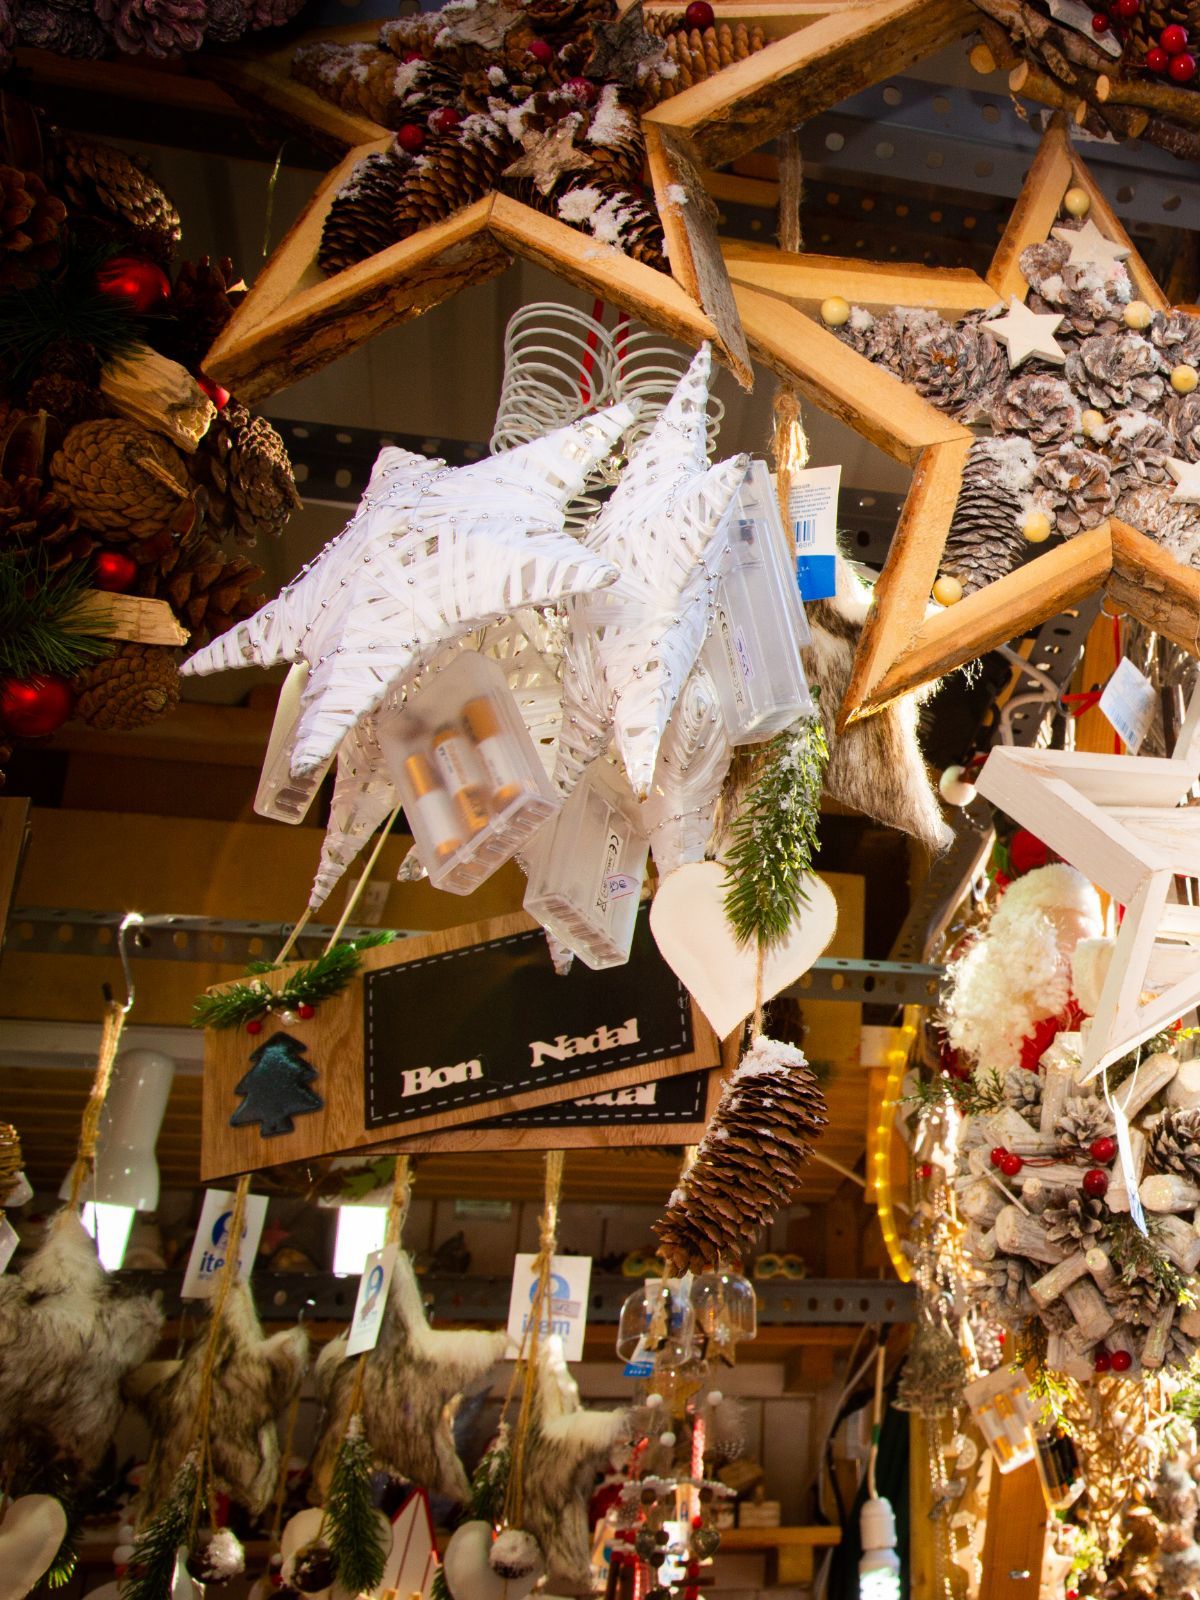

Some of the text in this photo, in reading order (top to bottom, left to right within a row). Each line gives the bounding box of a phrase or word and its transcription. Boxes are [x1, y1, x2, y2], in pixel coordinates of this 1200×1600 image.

[401, 1017, 642, 1098] Bon Nadal
[199, 1251, 243, 1274] ite
